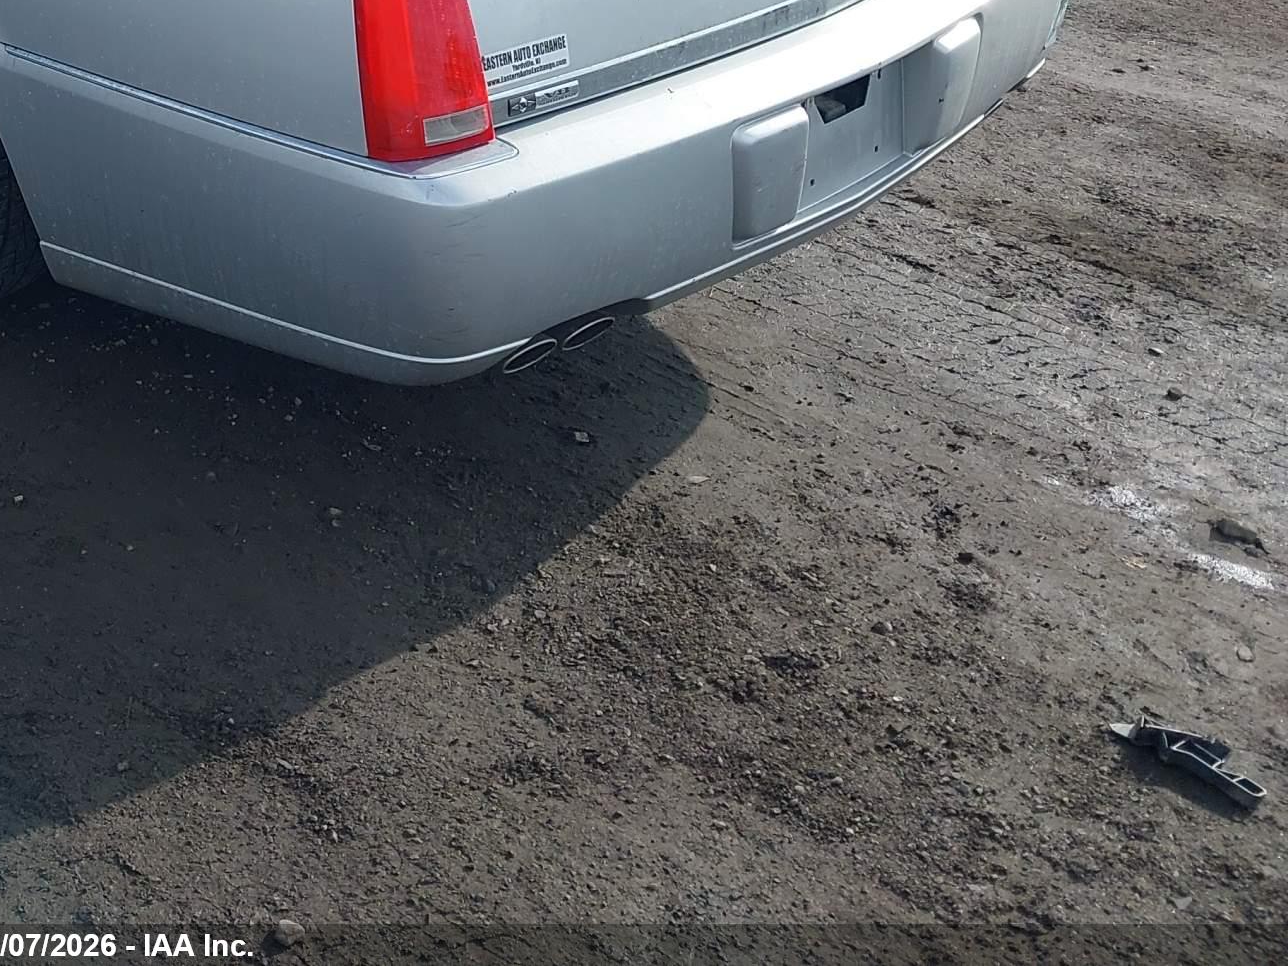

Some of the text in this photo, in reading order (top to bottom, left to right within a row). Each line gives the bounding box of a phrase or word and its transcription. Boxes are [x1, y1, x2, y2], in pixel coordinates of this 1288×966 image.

[482, 35, 567, 71] EASTERN AUTO EXCHANGE
